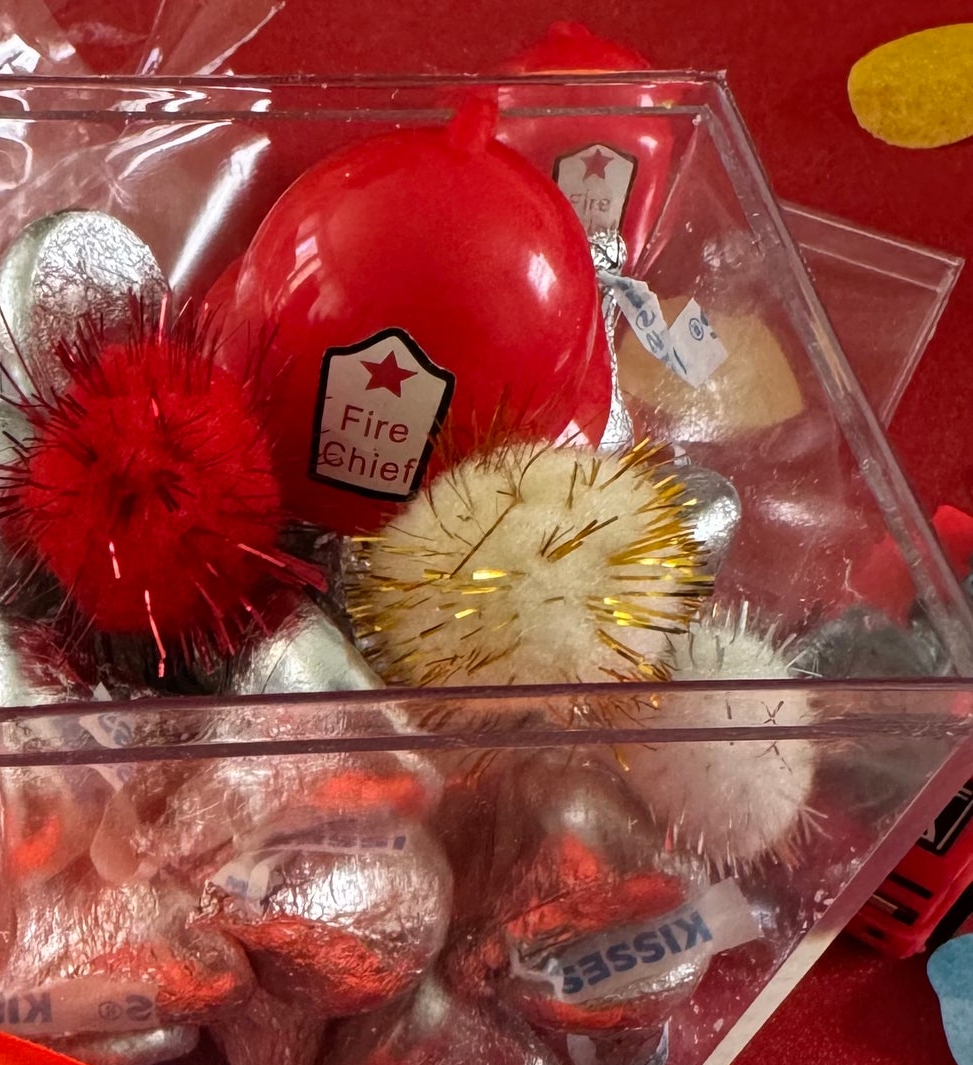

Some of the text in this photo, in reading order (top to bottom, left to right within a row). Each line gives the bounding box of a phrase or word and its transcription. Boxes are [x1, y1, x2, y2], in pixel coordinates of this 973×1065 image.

[340, 403, 410, 443] Fire
[323, 440, 418, 484] Chief
[562, 909, 714, 994] KISSES
